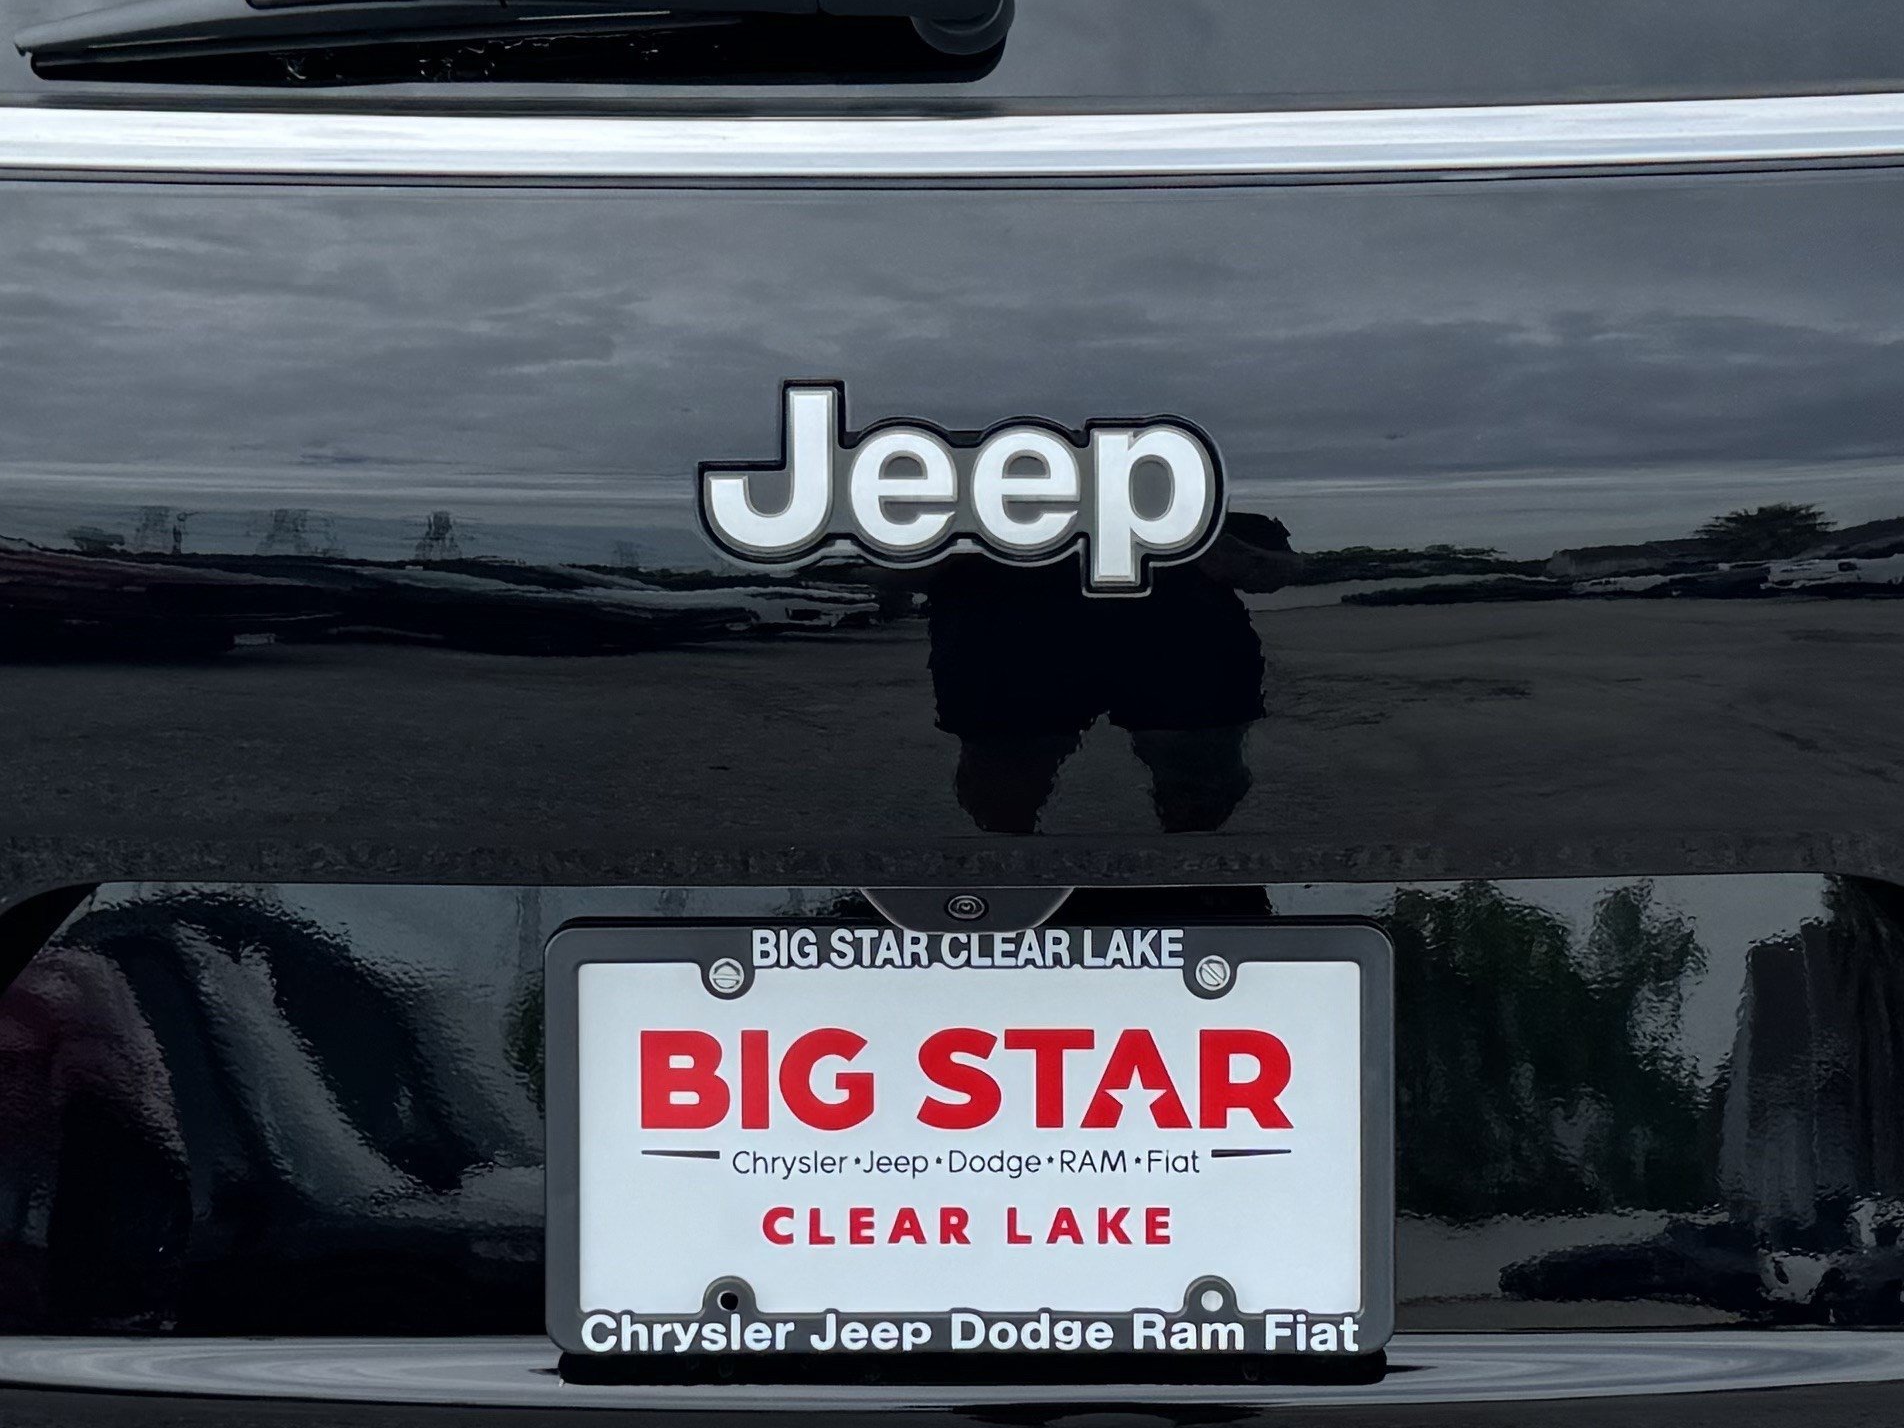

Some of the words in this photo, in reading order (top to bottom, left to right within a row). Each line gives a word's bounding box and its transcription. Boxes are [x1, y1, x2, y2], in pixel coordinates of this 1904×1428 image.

[703, 385, 1212, 586] Jeep
[751, 928, 820, 967] BIG
[829, 927, 930, 967] STAR
[940, 927, 1072, 967] CLEAR
[1082, 928, 1186, 967] LAKE
[639, 1027, 875, 1131] BIG
[916, 1027, 1293, 1131] STAR
[761, 1206, 972, 1246] CLEAR
[1006, 1206, 1173, 1246] LAKE
[580, 1313, 795, 1353] Chrysler
[809, 1313, 932, 1352] Jeep
[950, 1312, 1114, 1351] Dodge
[1132, 1313, 1245, 1351] Ram
[1264, 1313, 1360, 1352] Fiat
